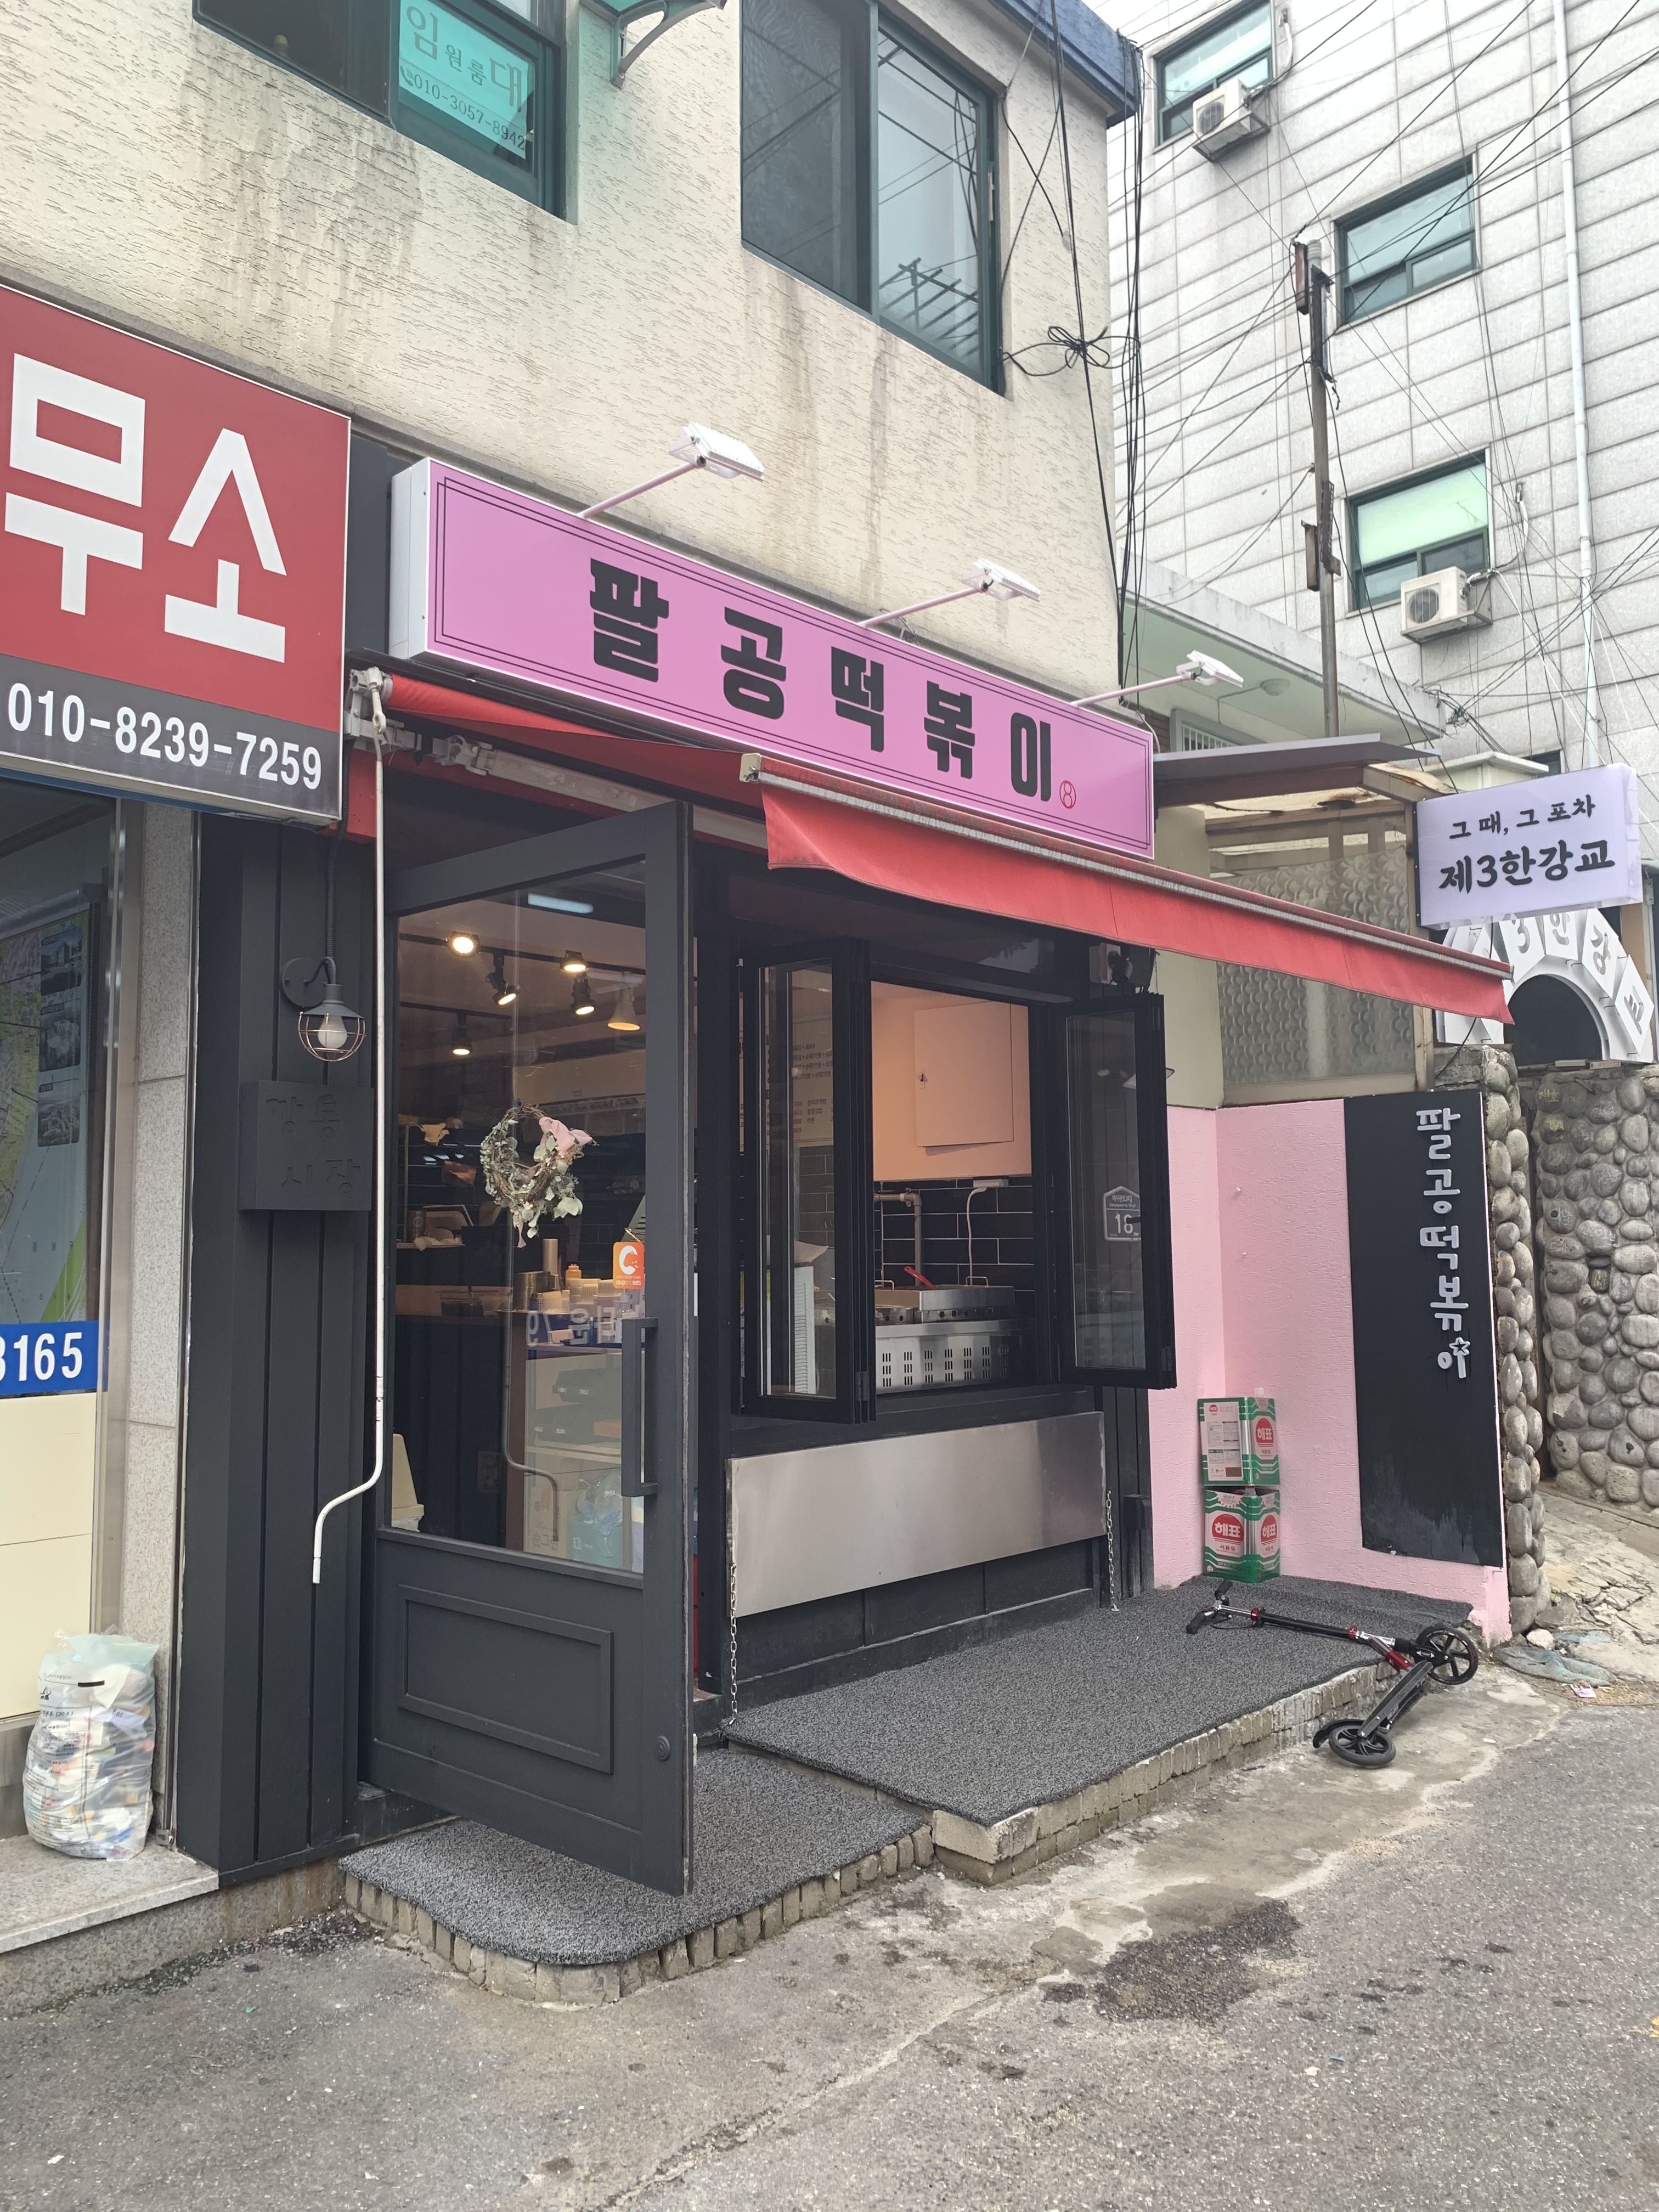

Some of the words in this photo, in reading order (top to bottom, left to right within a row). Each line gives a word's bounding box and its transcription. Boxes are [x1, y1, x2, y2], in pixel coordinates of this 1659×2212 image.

[444, 44, 487, 87] 원룸
[414, 74, 526, 151] 010-3057-8942
[4, 353, 287, 664] 무소
[589, 557, 1052, 802] 팔공떡볶이
[8, 682, 323, 790] 010-8239-7259
[1438, 838, 1616, 894] 제3한강교
[1257, 1427, 1273, 1441] 해표
[1214, 1521, 1241, 1538] 해표
[1262, 1523, 1276, 1538] 해표
